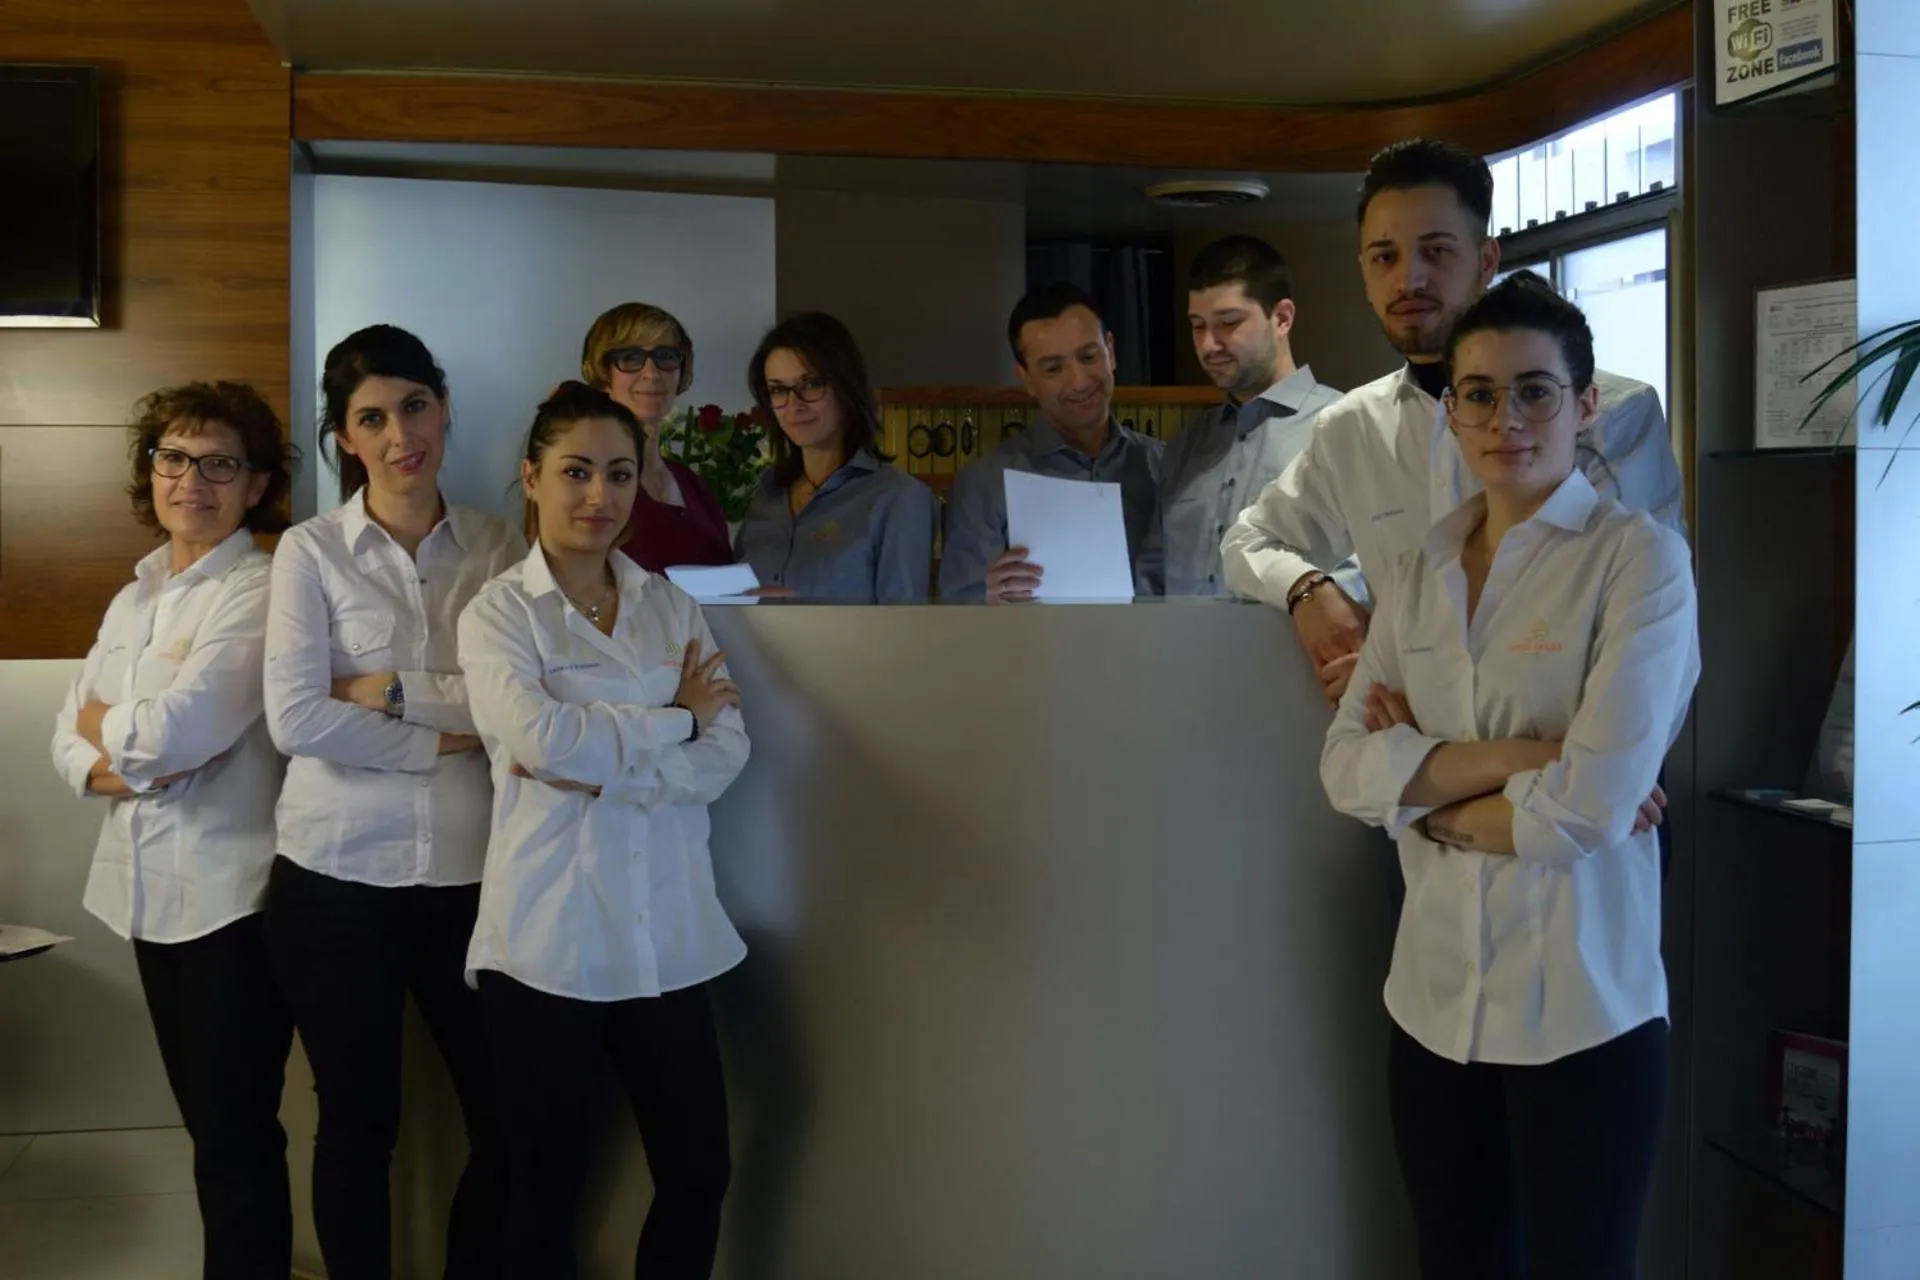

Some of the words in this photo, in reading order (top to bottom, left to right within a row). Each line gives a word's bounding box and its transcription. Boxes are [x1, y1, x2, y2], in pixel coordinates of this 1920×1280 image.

[1727, 0, 1771, 24] FREE
[1779, 45, 1821, 66] facebook
[1727, 57, 1775, 83] ZONE
